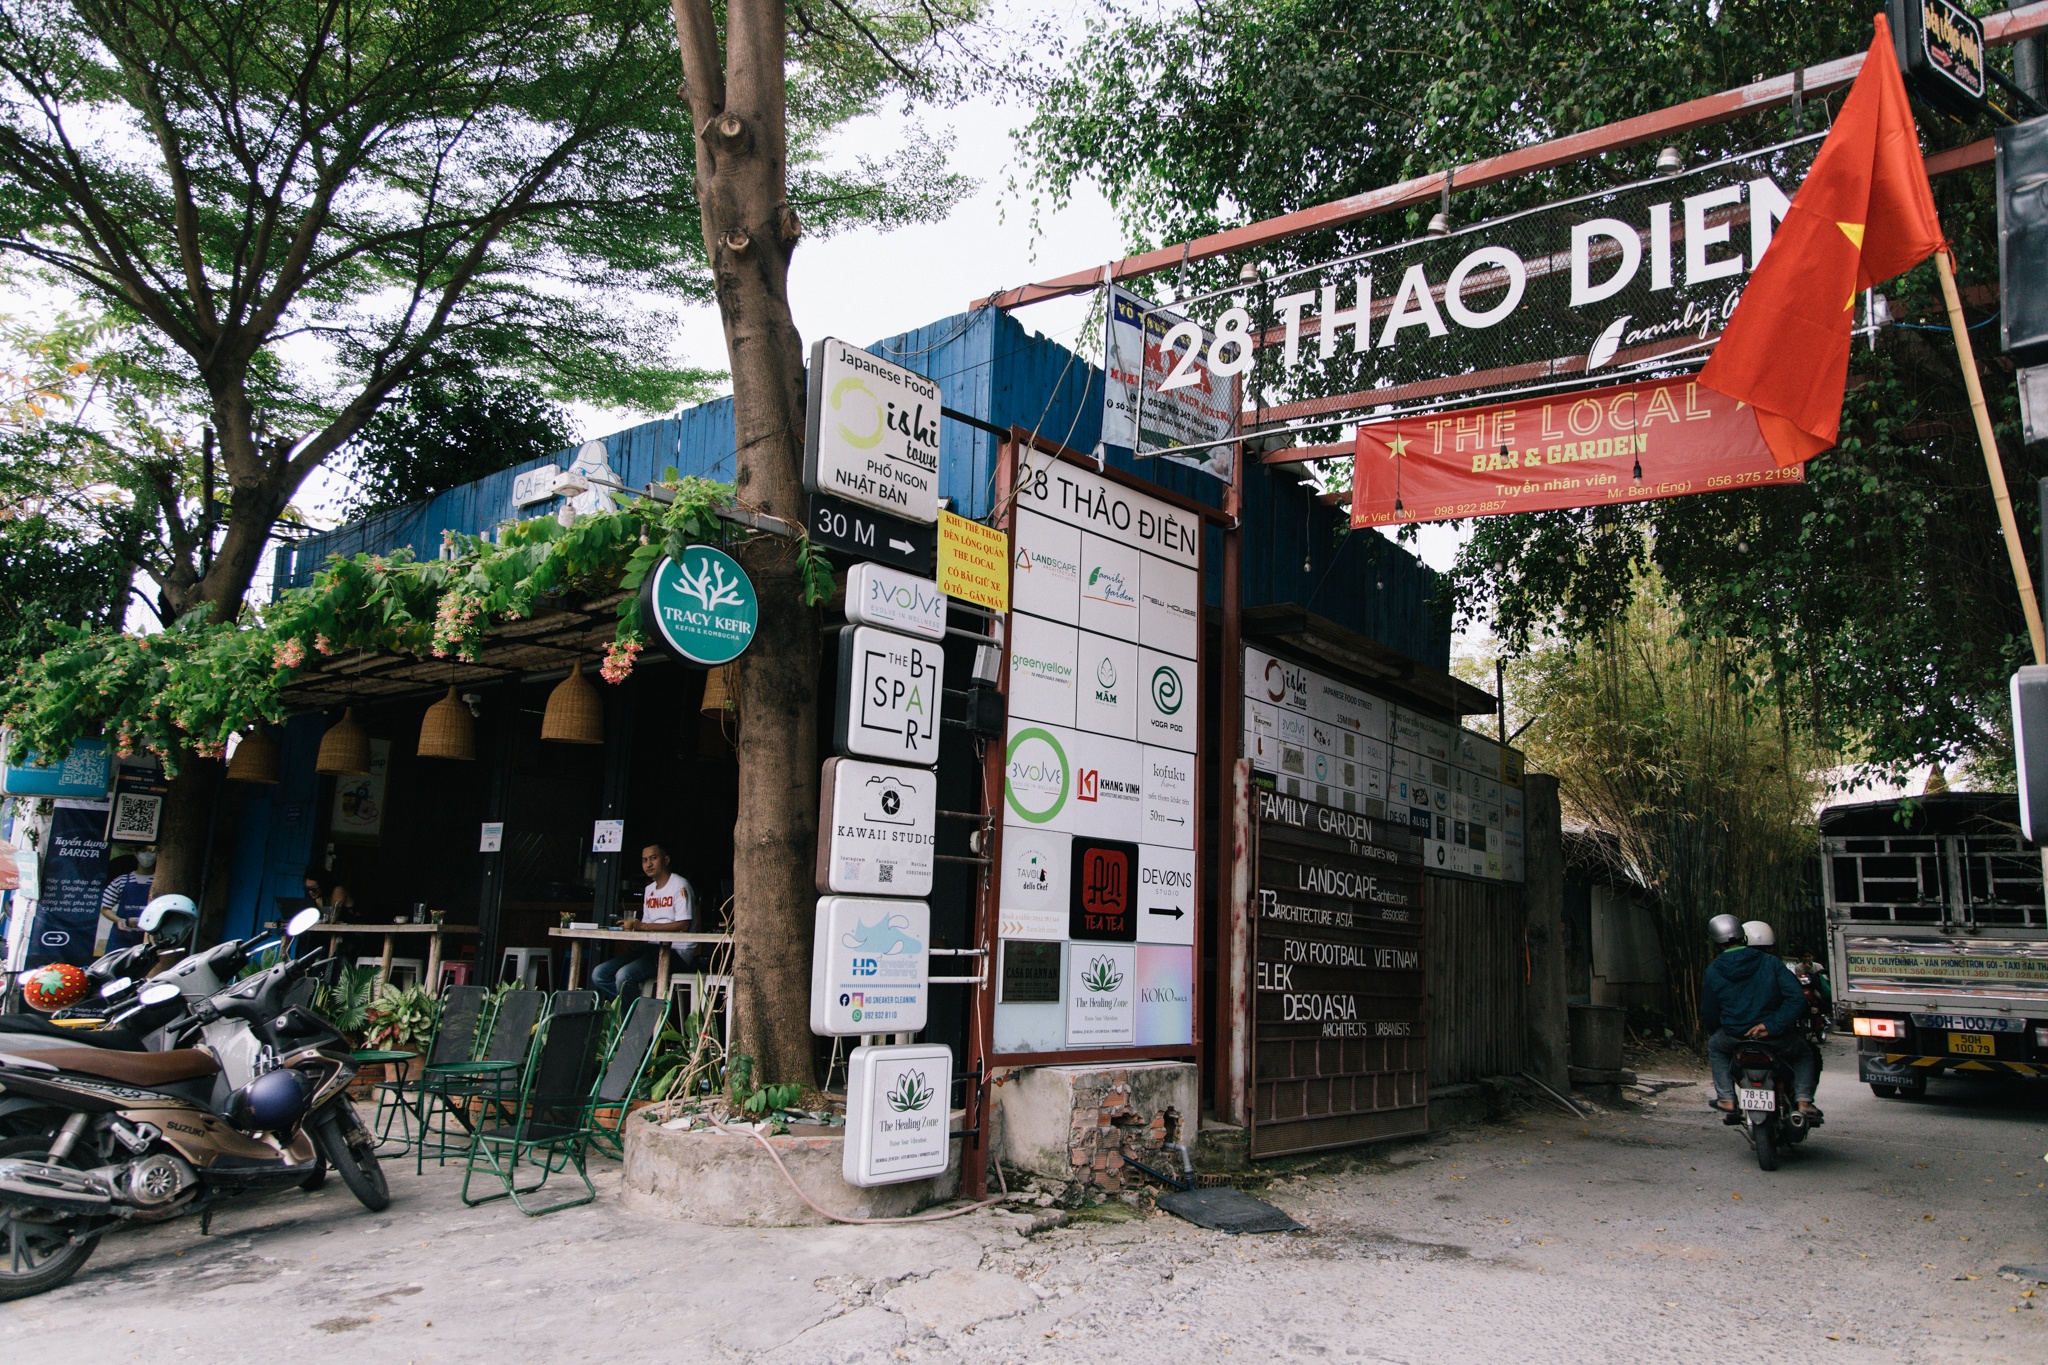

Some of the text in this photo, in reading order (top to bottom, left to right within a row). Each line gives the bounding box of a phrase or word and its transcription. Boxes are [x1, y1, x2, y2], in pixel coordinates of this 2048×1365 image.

[1157, 308, 1254, 392] 28
[1273, 246, 1526, 367] THAO
[839, 348, 934, 400] Japanese Food
[1426, 382, 1711, 455] THE LOCAL
[906, 440, 937, 469] town
[1471, 433, 1648, 473] BAR & GARDEN
[867, 458, 928, 491] PHỐ NGON
[1607, 467, 1800, 499] Mr Ben (Eng) 056 375 2199
[835, 468, 908, 506] NHẬT BẢN
[1496, 473, 1617, 496] Tuyển nhân viên
[1017, 463, 1196, 556] 28 THẢO ĐIỀN
[1355, 500, 1507, 524] Mr Viet 098 922 8857
[818, 508, 875, 547] 30 M
[946, 514, 962, 528] KHU
[981, 527, 1002, 542] THAO
[953, 548, 995, 571] THE LOCAL
[1031, 551, 1077, 574] LANDSCAPE
[947, 566, 959, 577] CÓ
[991, 580, 1001, 592] XE
[1042, 564, 1077, 578] ARCHITECTURE
[1104, 585, 1135, 603] Garden
[664, 606, 751, 634] TRACY KEFIR
[871, 605, 896, 616] EVOLVE
[908, 613, 940, 628] WELLNESS
[675, 625, 695, 633] KEFIR
[703, 630, 740, 641] KOMBUCHA
[889, 652, 908, 667] THE
[1011, 654, 1072, 677] greenyellow
[1323, 685, 1373, 710] JAPANESE FOOD STREET
[1151, 719, 1183, 732] YOGA POD
[1337, 713, 1348, 724] 15M
[1153, 763, 1186, 781] kofuku
[1100, 779, 1140, 795] KHANG VINH
[1150, 809, 1165, 822] 50m
[1259, 791, 1372, 842] FAMILY GARDEN
[83, 839, 109, 850] dụng
[838, 826, 936, 845] KAWAII STUDIO
[59, 848, 100, 859] BARISTA
[1385, 850, 1399, 865] way
[1036, 882, 1048, 891] Chef
[1299, 864, 1377, 901] LANDSCAPE
[646, 896, 673, 908] MONACO
[1085, 914, 1124, 931] TEA TEA
[1335, 912, 1353, 927] ASIA
[1284, 939, 1418, 969] FOX FOOTBALL VIETNAM
[853, 958, 878, 976] HD
[2004, 961, 2020, 970] TAXI
[1257, 961, 1293, 991] ELEK
[865, 996, 916, 1004] HD SNEAKER CLEANING
[1075, 997, 1128, 1010] The Healing Zone
[1141, 987, 1174, 1003] KOKO
[1283, 993, 1357, 1021] DESO ASIA
[1322, 1022, 1410, 1037] ARCHITECTS URBANISTS
[1927, 1015, 2008, 1031] 50H-100.79
[1955, 1043, 1990, 1054] 100.79
[1961, 1035, 1981, 1044] 50H
[1742, 1099, 1773, 1110] 102.70
[166, 1120, 205, 1138] SUZUKI
[880, 1116, 938, 1132] The Healing Zone
